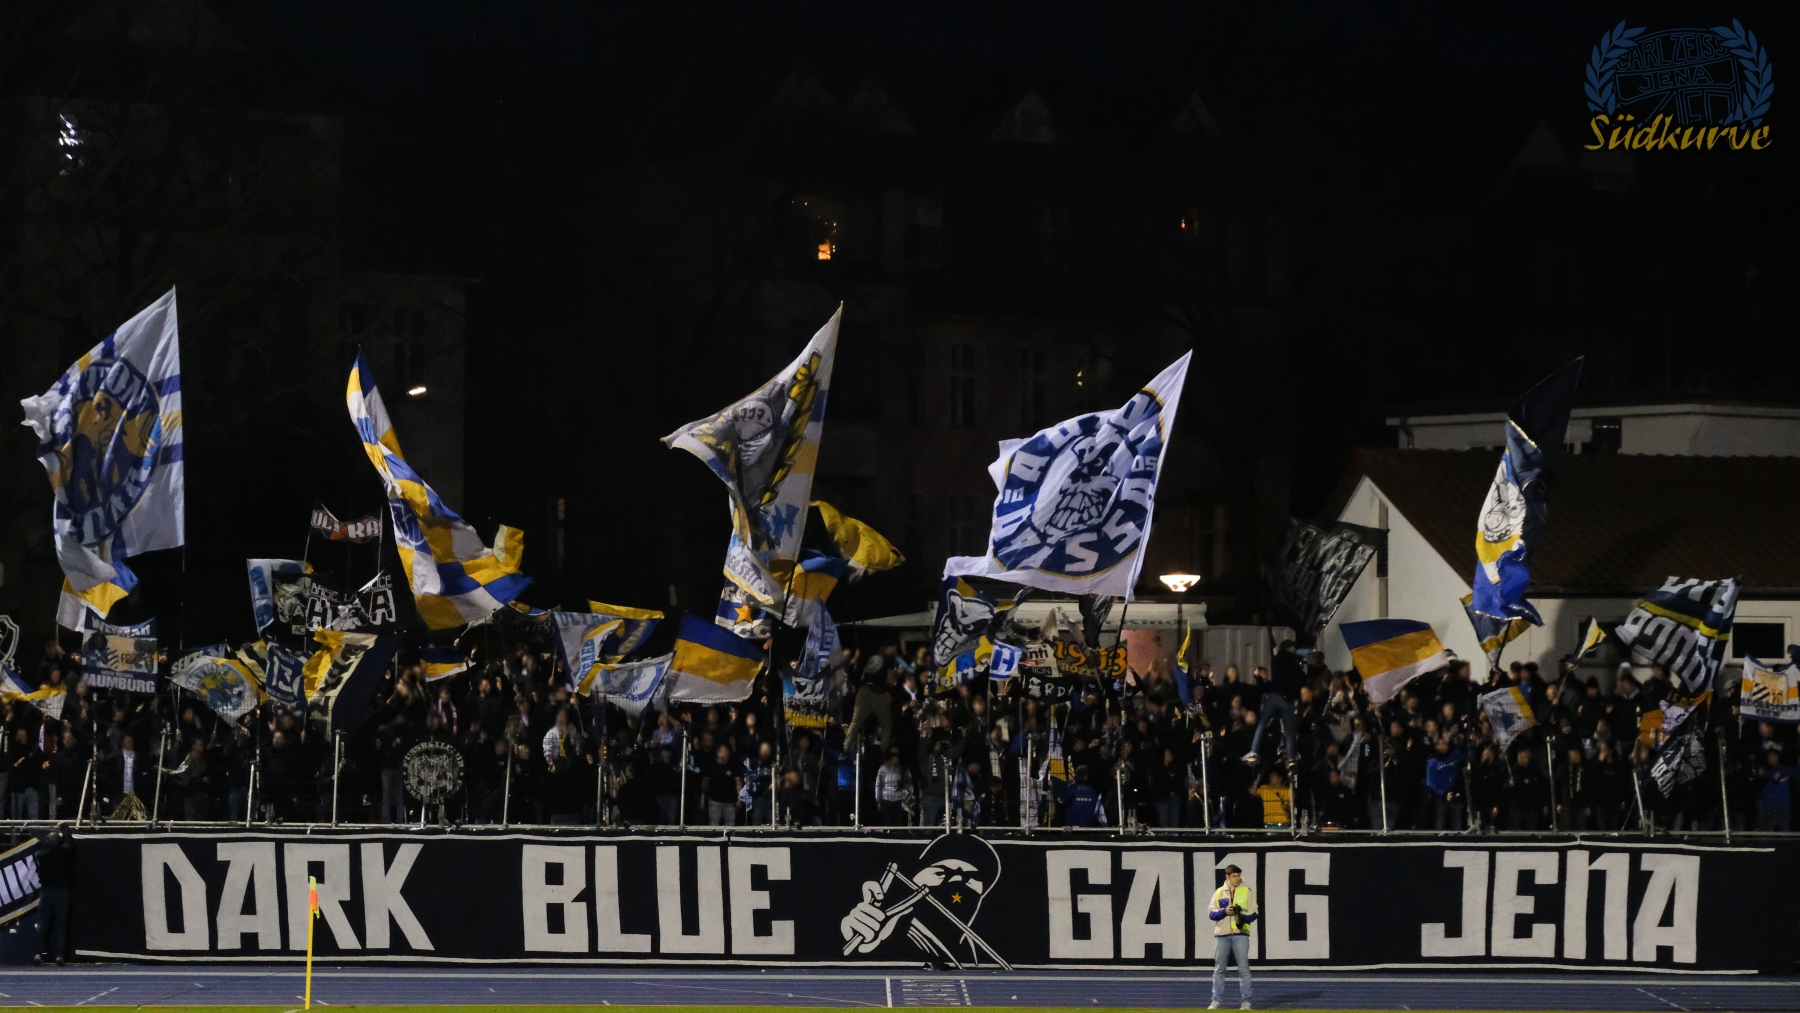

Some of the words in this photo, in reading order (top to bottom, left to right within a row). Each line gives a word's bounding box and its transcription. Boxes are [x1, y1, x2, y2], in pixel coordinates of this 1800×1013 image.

[141, 842, 436, 951] DARK
[522, 844, 795, 955] BLUE
[1046, 850, 1331, 960] GANG
[1421, 850, 1701, 963] JENA
